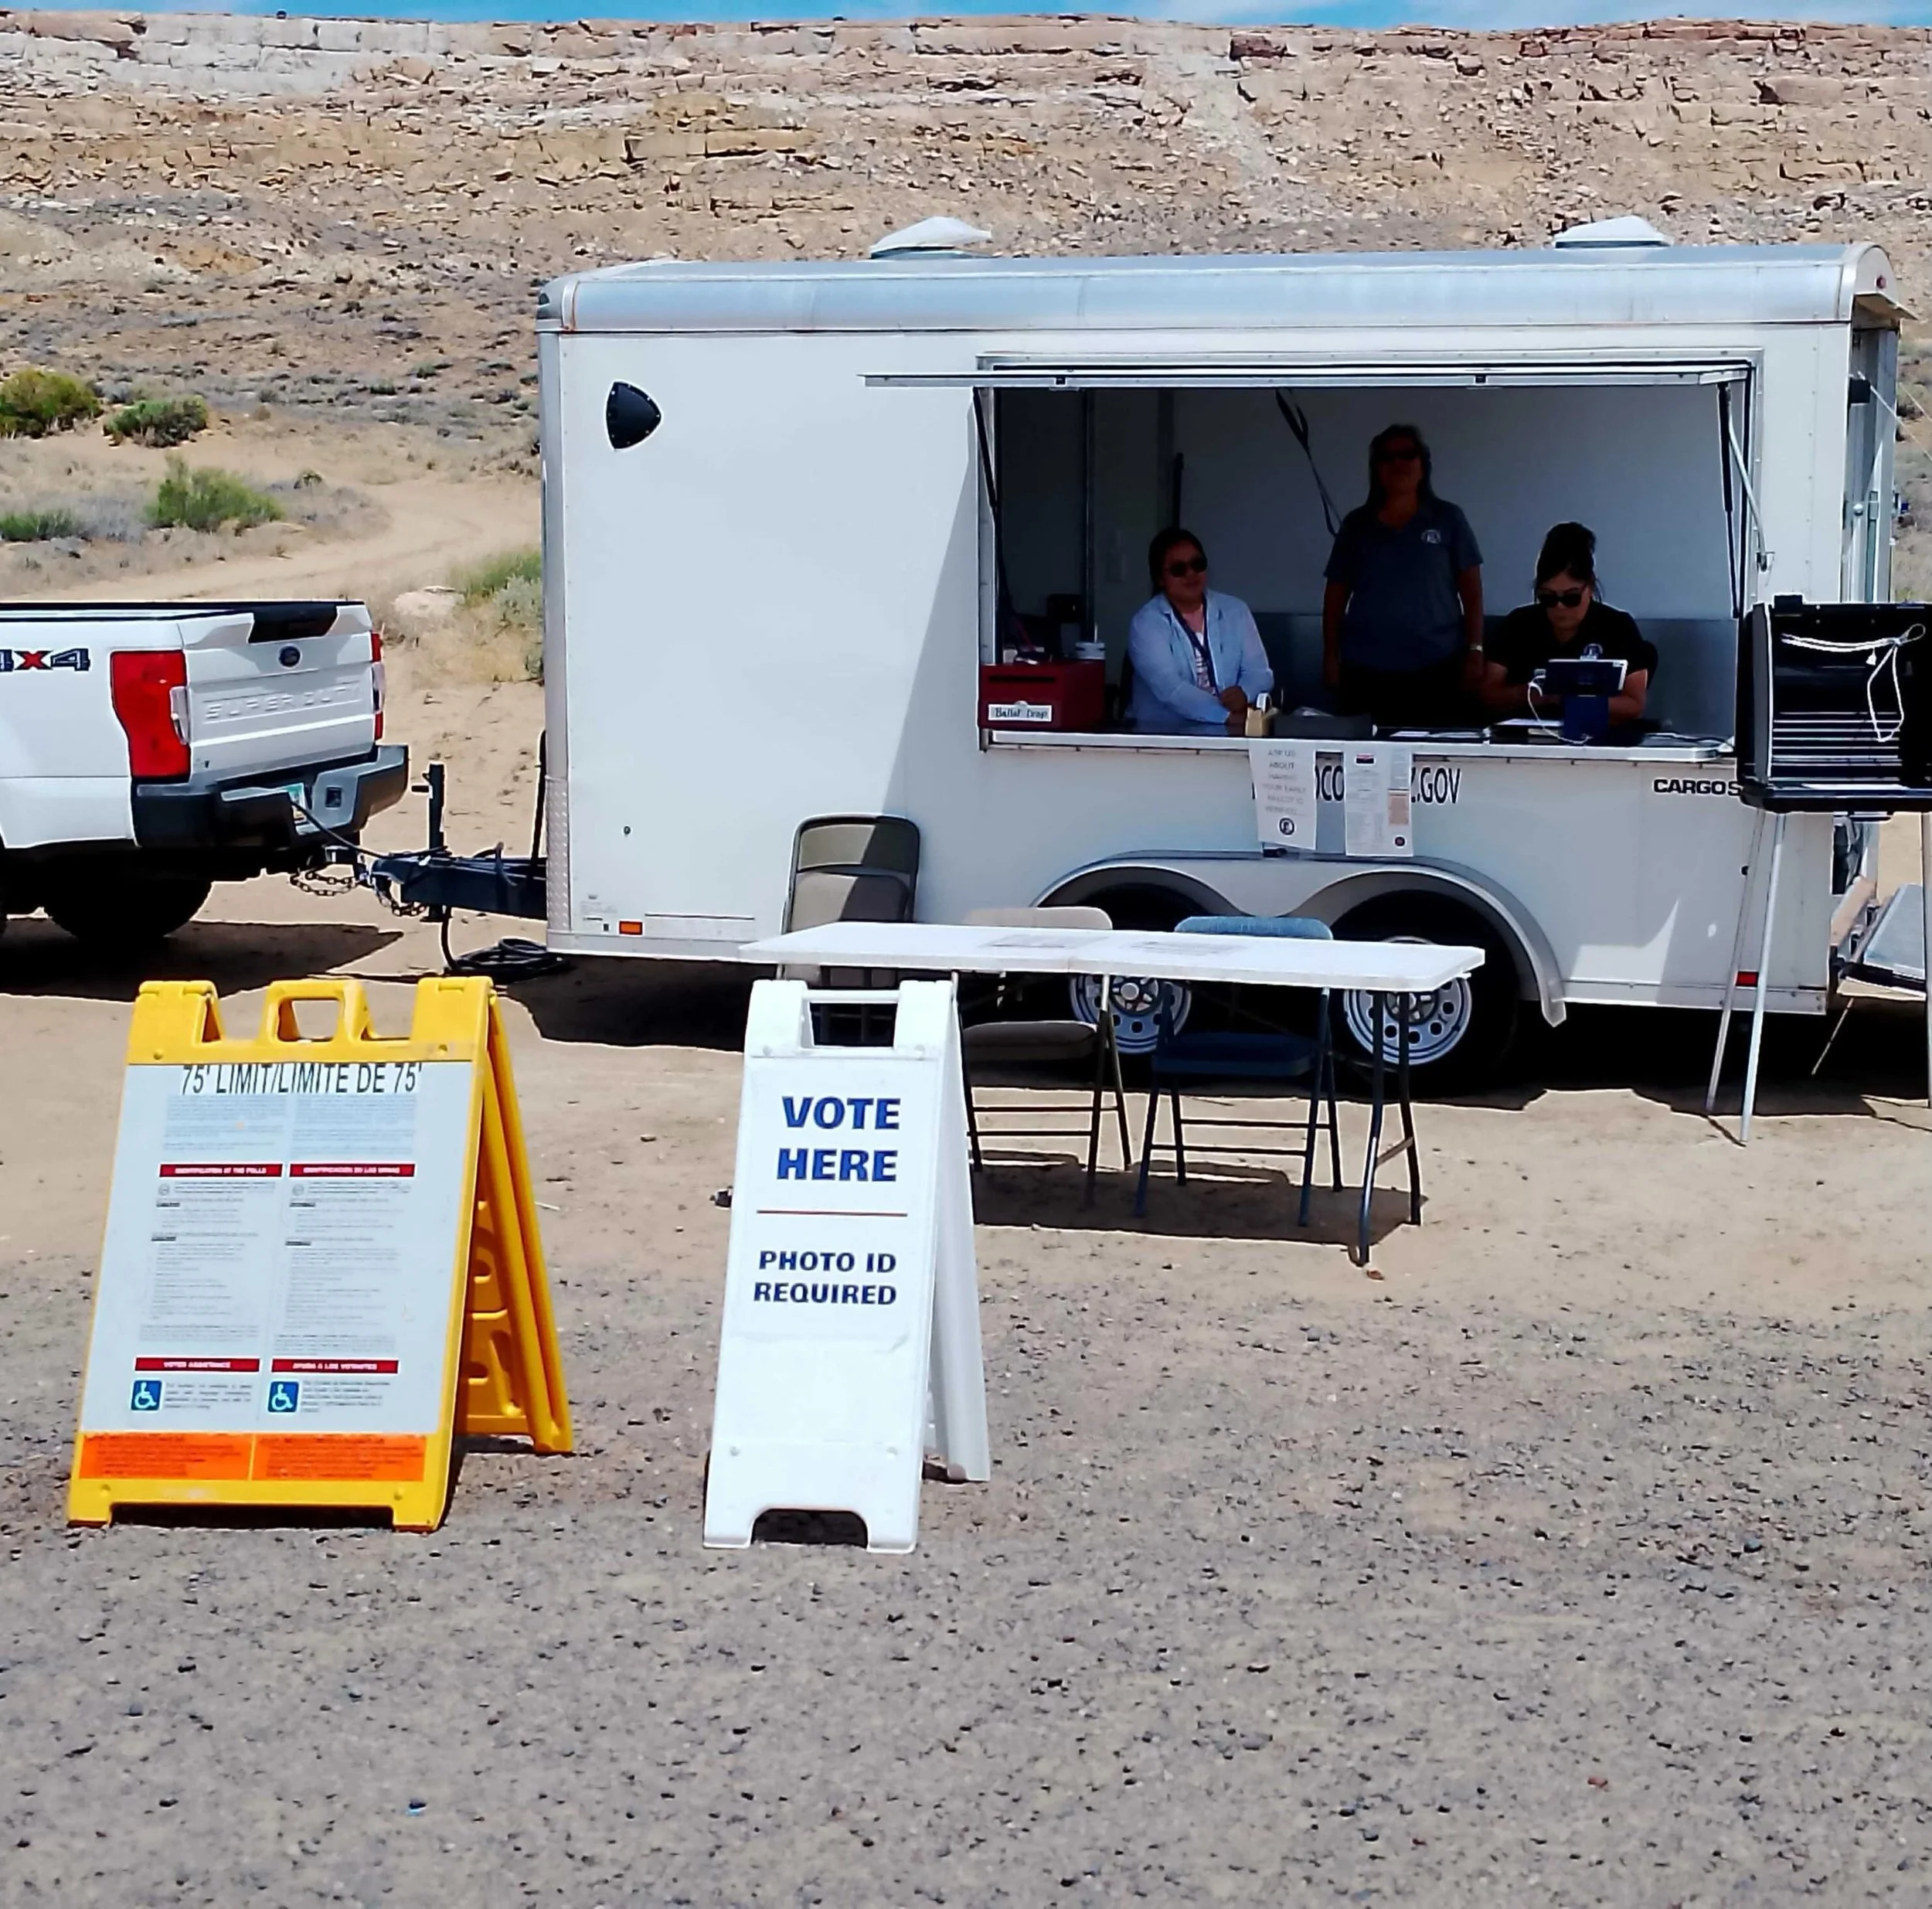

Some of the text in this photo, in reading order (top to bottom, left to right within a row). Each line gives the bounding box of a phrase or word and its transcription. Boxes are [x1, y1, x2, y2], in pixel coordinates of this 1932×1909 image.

[995, 707, 1048, 719] Ballot Drop
[182, 1063, 422, 1094] 75' LIMIT/LIMITE DE 75'
[782, 1096, 900, 1130] VOTE
[777, 1148, 898, 1182] HERE
[759, 1251, 896, 1273] PHOTO ID
[753, 1282, 896, 1305] REQUIRED
